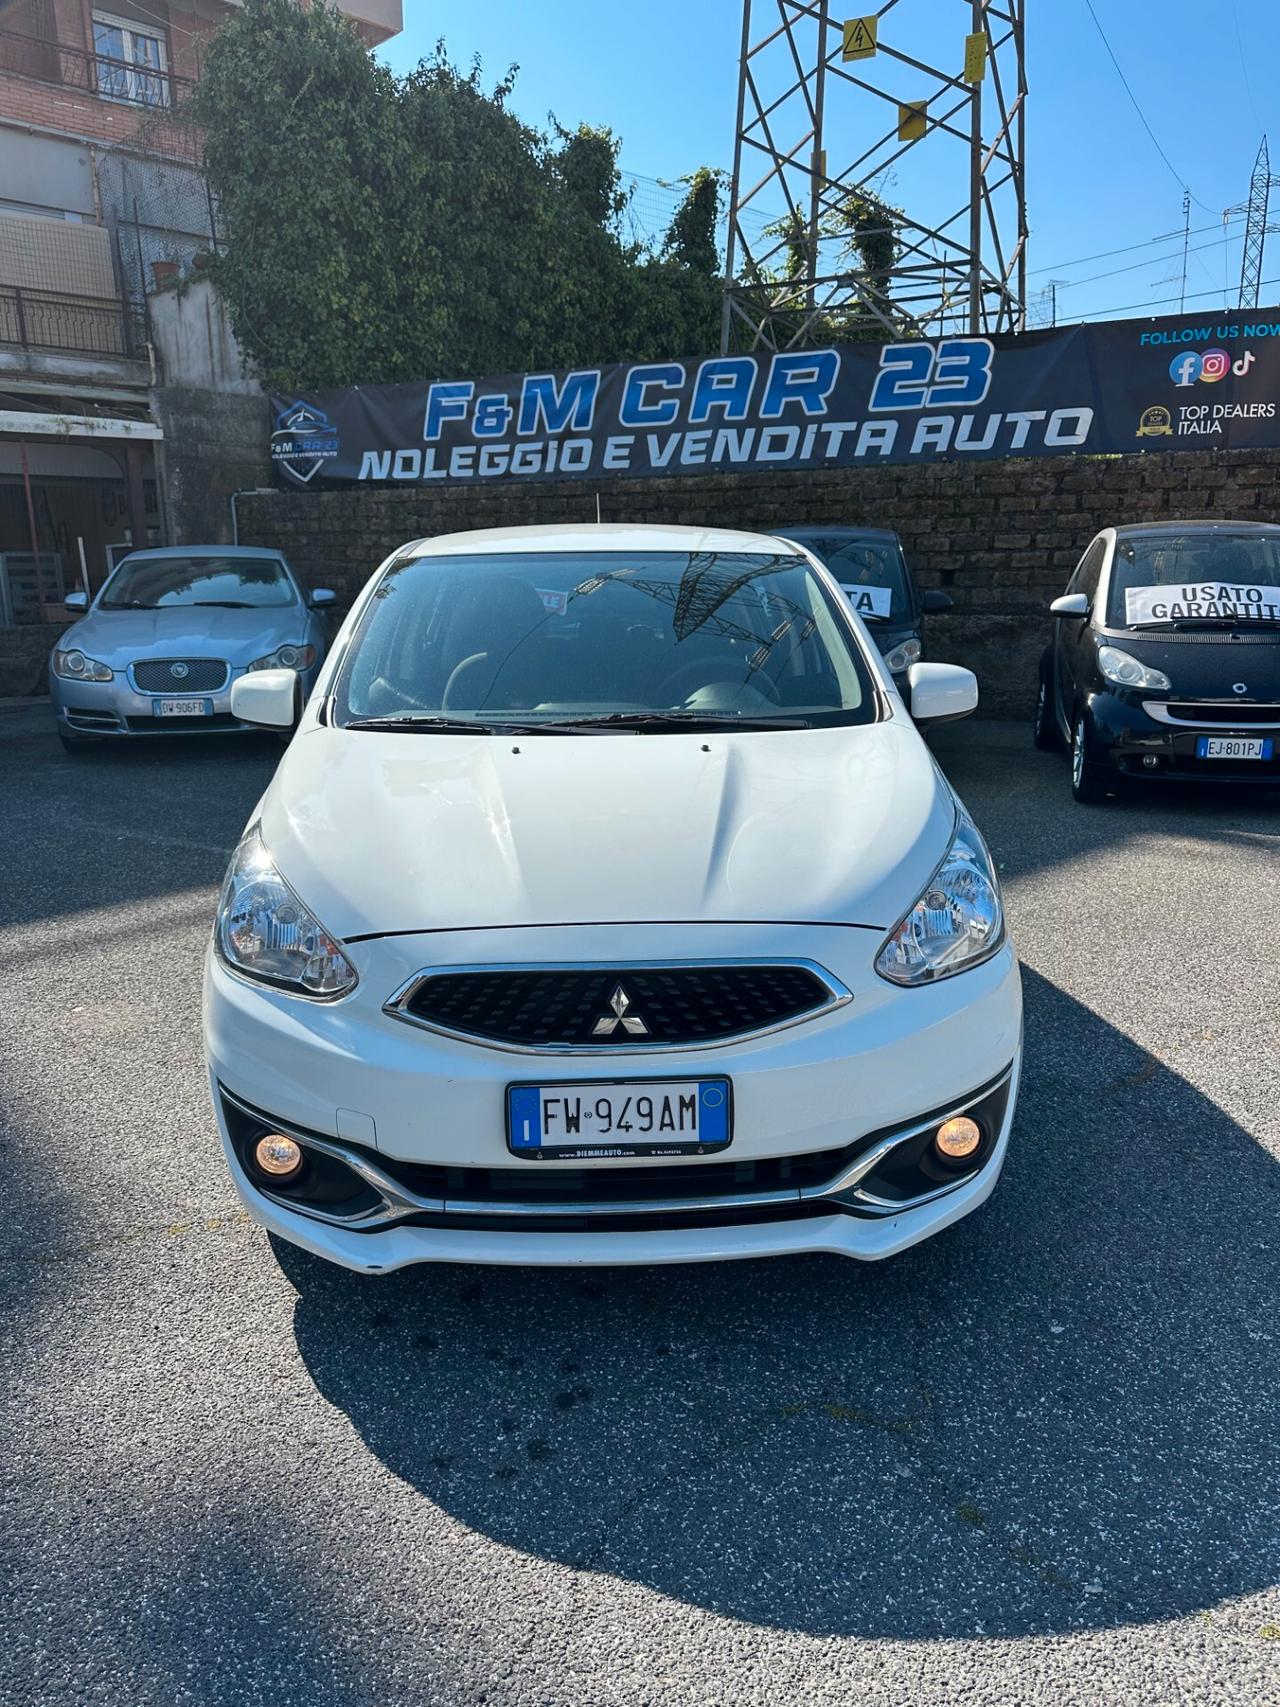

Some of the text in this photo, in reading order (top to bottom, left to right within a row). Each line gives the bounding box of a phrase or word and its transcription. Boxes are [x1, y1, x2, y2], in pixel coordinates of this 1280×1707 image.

[1140, 324, 1280, 346] FOLLOW US NOW
[423, 338, 995, 441] F&M CAR 23
[1179, 403, 1276, 420] TOP DEALERS
[1178, 420, 1222, 435] ITALIA
[603, 435, 634, 469] E
[647, 420, 898, 467] VENDITA
[910, 407, 1094, 453] AUTO
[1182, 585, 1263, 603] USATO
[1151, 601, 1280, 621] GARANTIT
